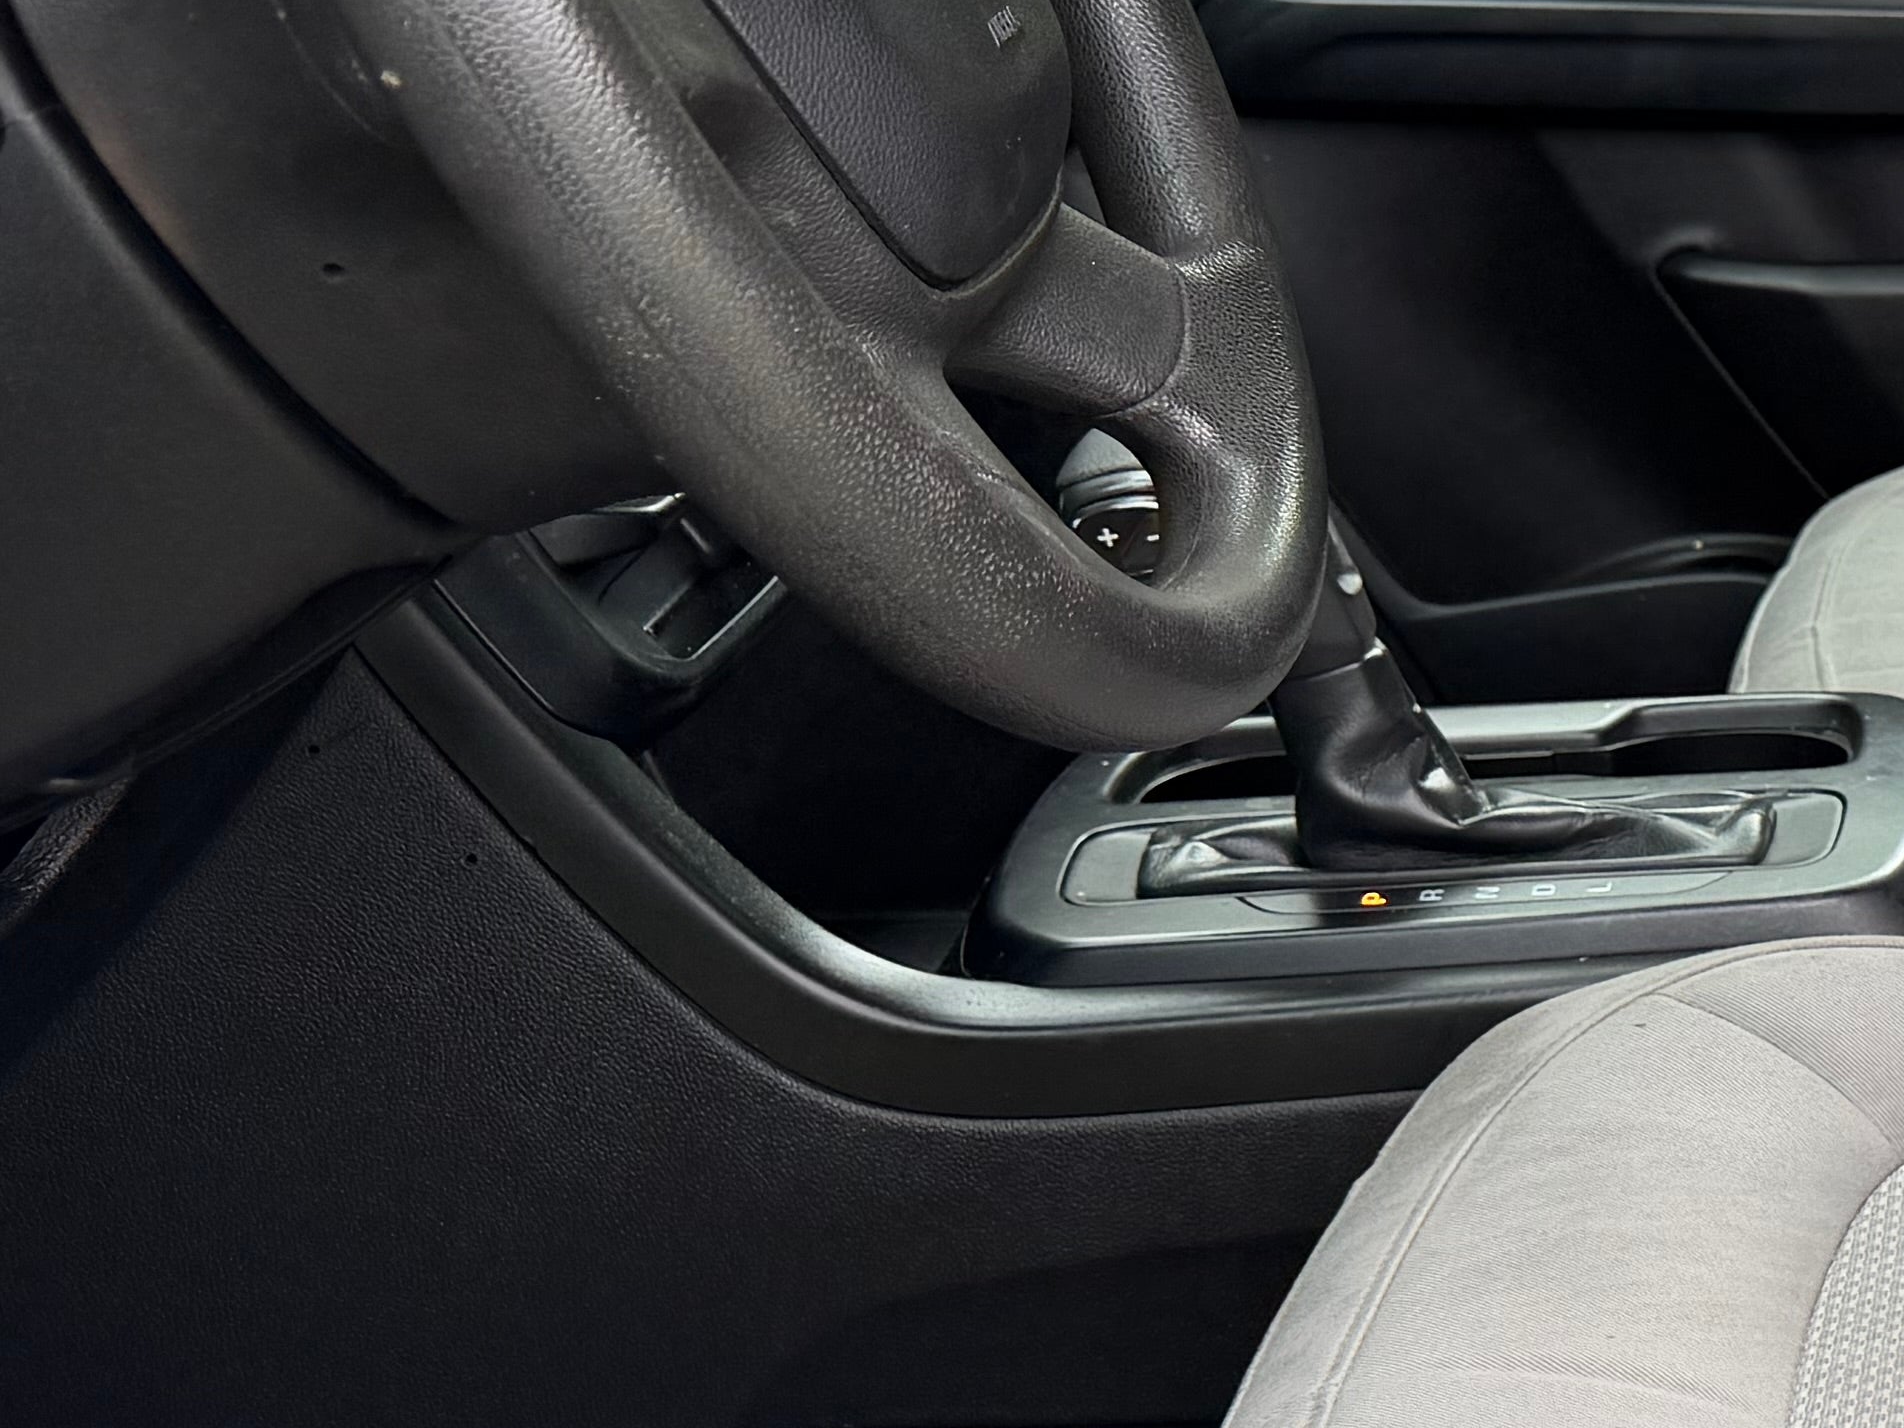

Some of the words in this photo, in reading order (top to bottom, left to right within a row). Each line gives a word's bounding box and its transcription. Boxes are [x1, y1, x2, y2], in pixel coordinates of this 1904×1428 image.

[1361, 892, 1387, 906] P
[1419, 888, 1444, 902] R
[1475, 886, 1500, 900] N
[1531, 884, 1556, 897] D
[1587, 882, 1612, 893] L
